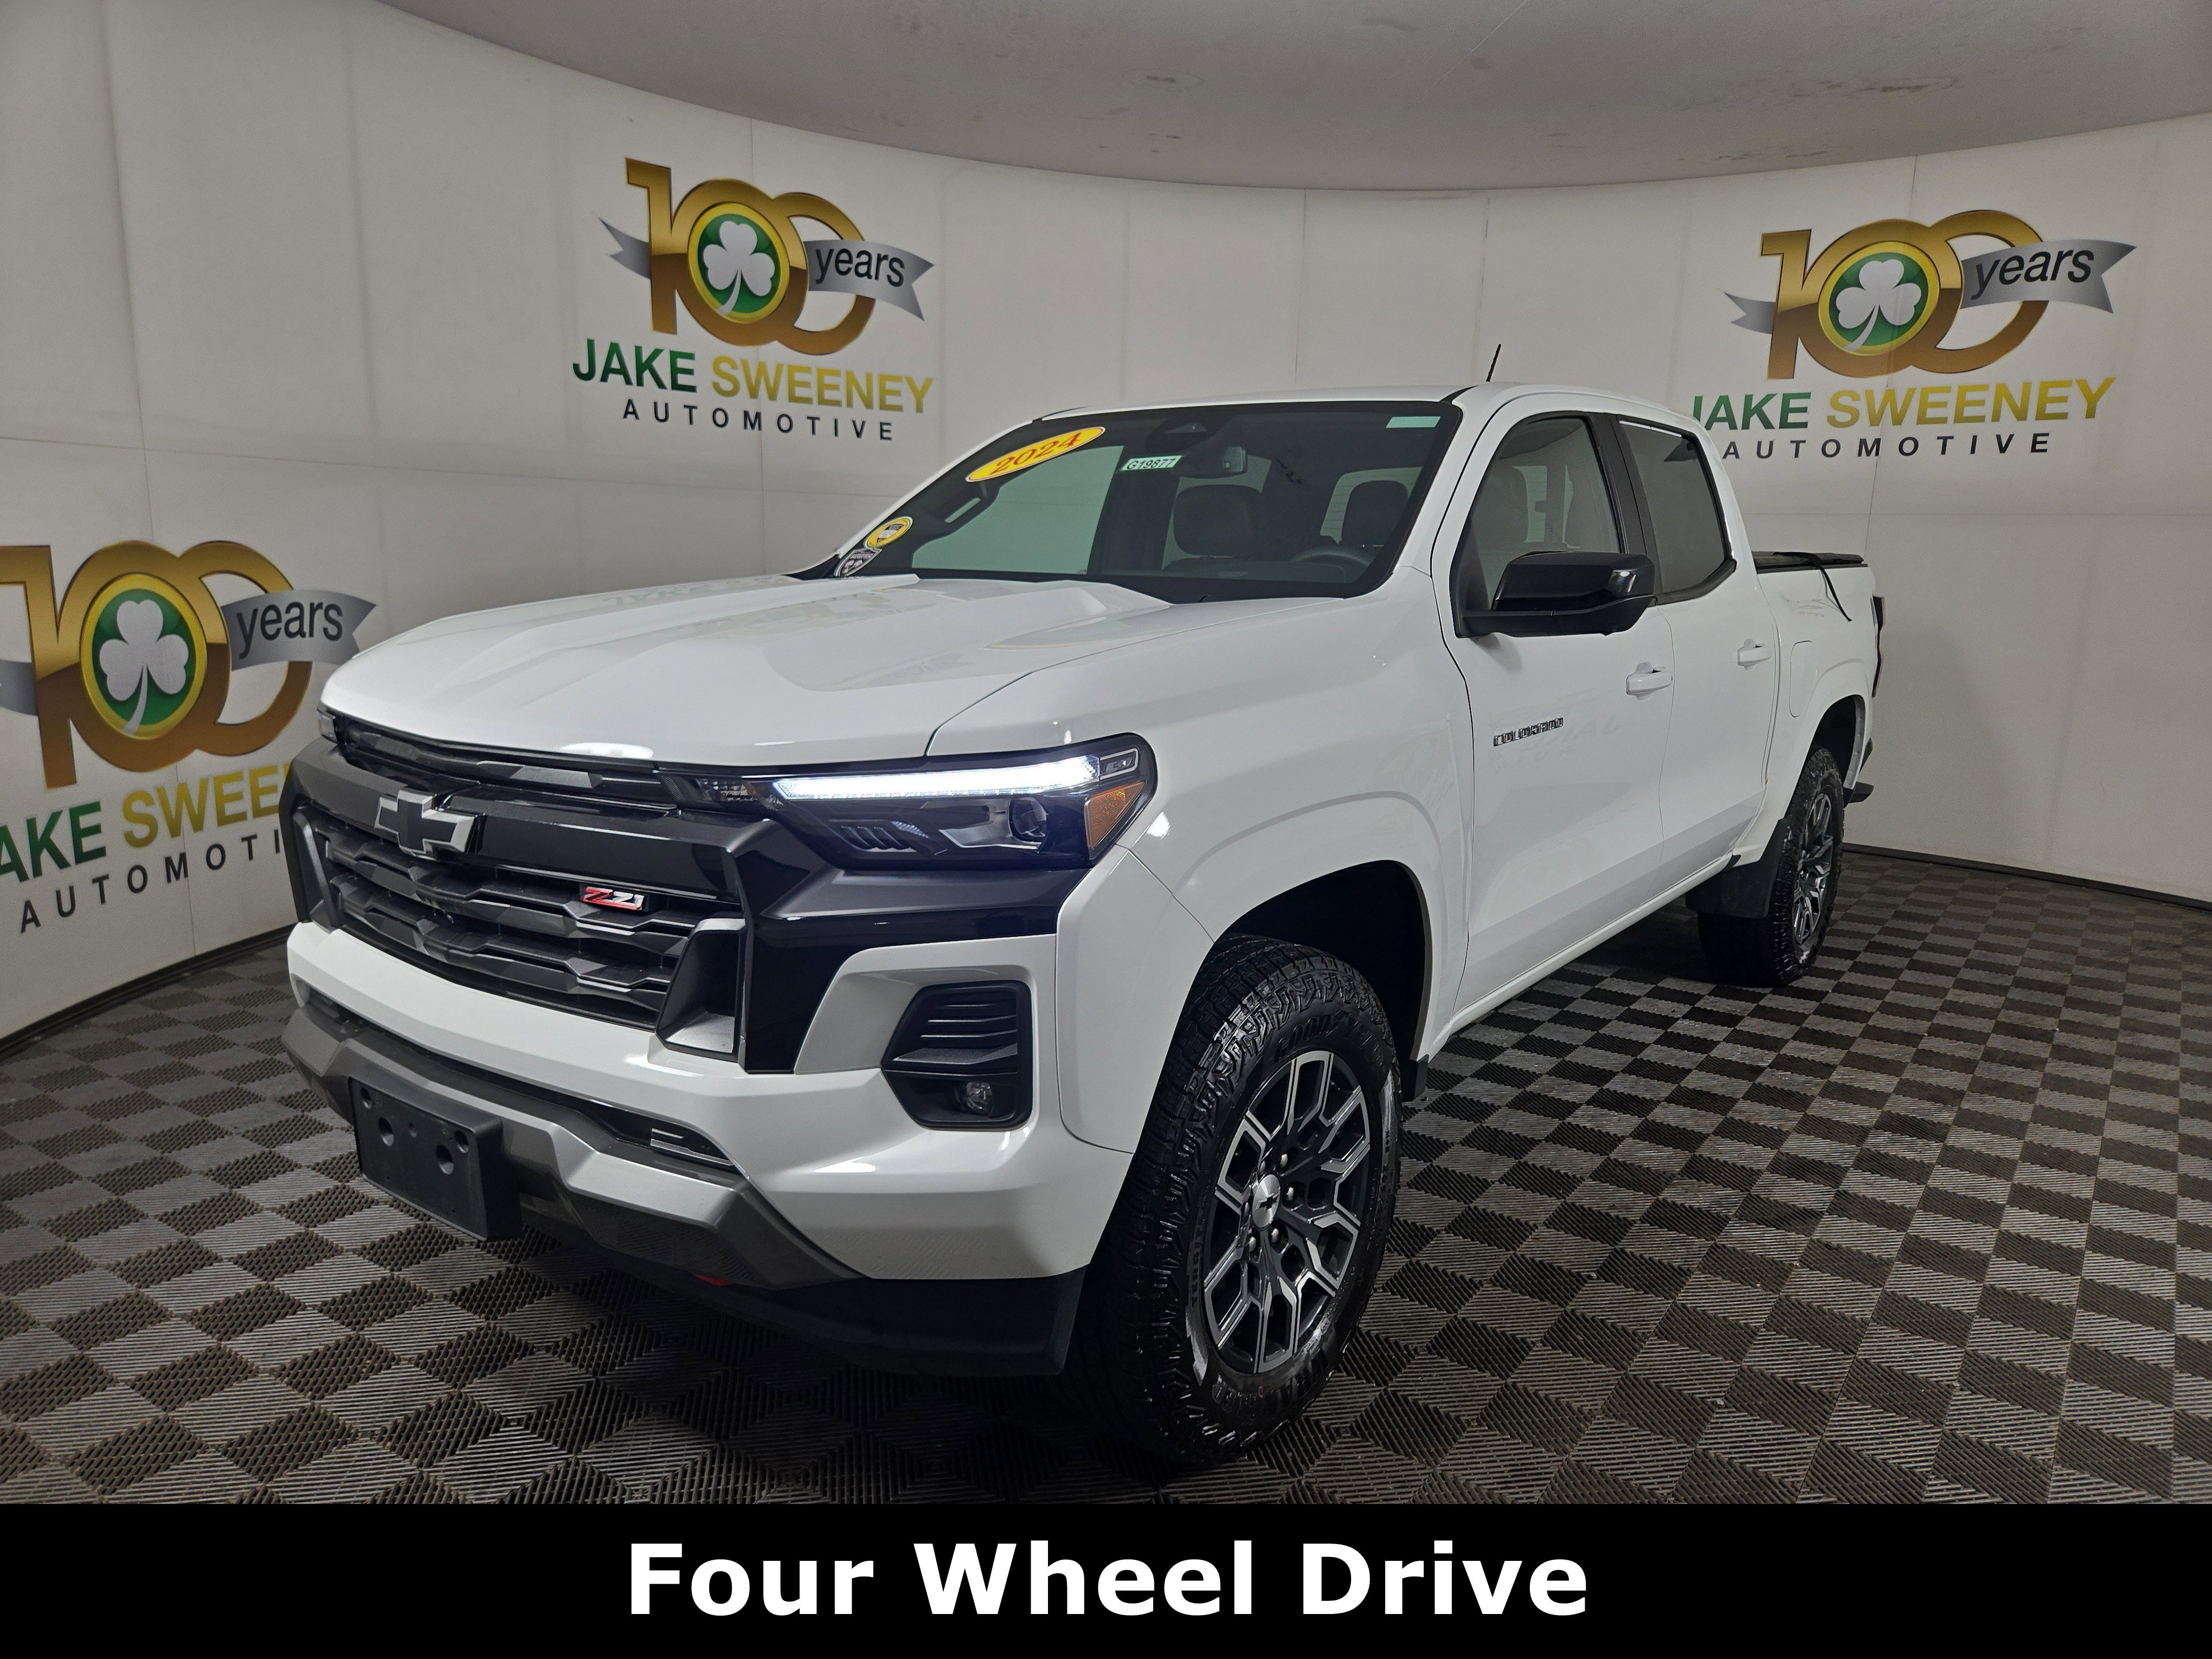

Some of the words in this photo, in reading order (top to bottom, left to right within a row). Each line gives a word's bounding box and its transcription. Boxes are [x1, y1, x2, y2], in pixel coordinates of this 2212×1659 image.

[815, 247, 905, 287] years
[1971, 247, 2095, 300] years
[573, 338, 698, 393] JAKE
[711, 356, 934, 414] SWEENEY
[622, 398, 893, 441] AUTOMOTIVE
[1827, 377, 2117, 429] SWEENEY
[989, 432, 1082, 475] 2024
[1127, 459, 1176, 470] G19877
[1722, 432, 2051, 460] AUTOMOTIVE
[236, 600, 344, 659] years
[0, 800, 107, 883] AKE
[123, 762, 291, 848] SWEE
[20, 829, 281, 934] AUTOMOTI
[583, 886, 645, 911] Z71
